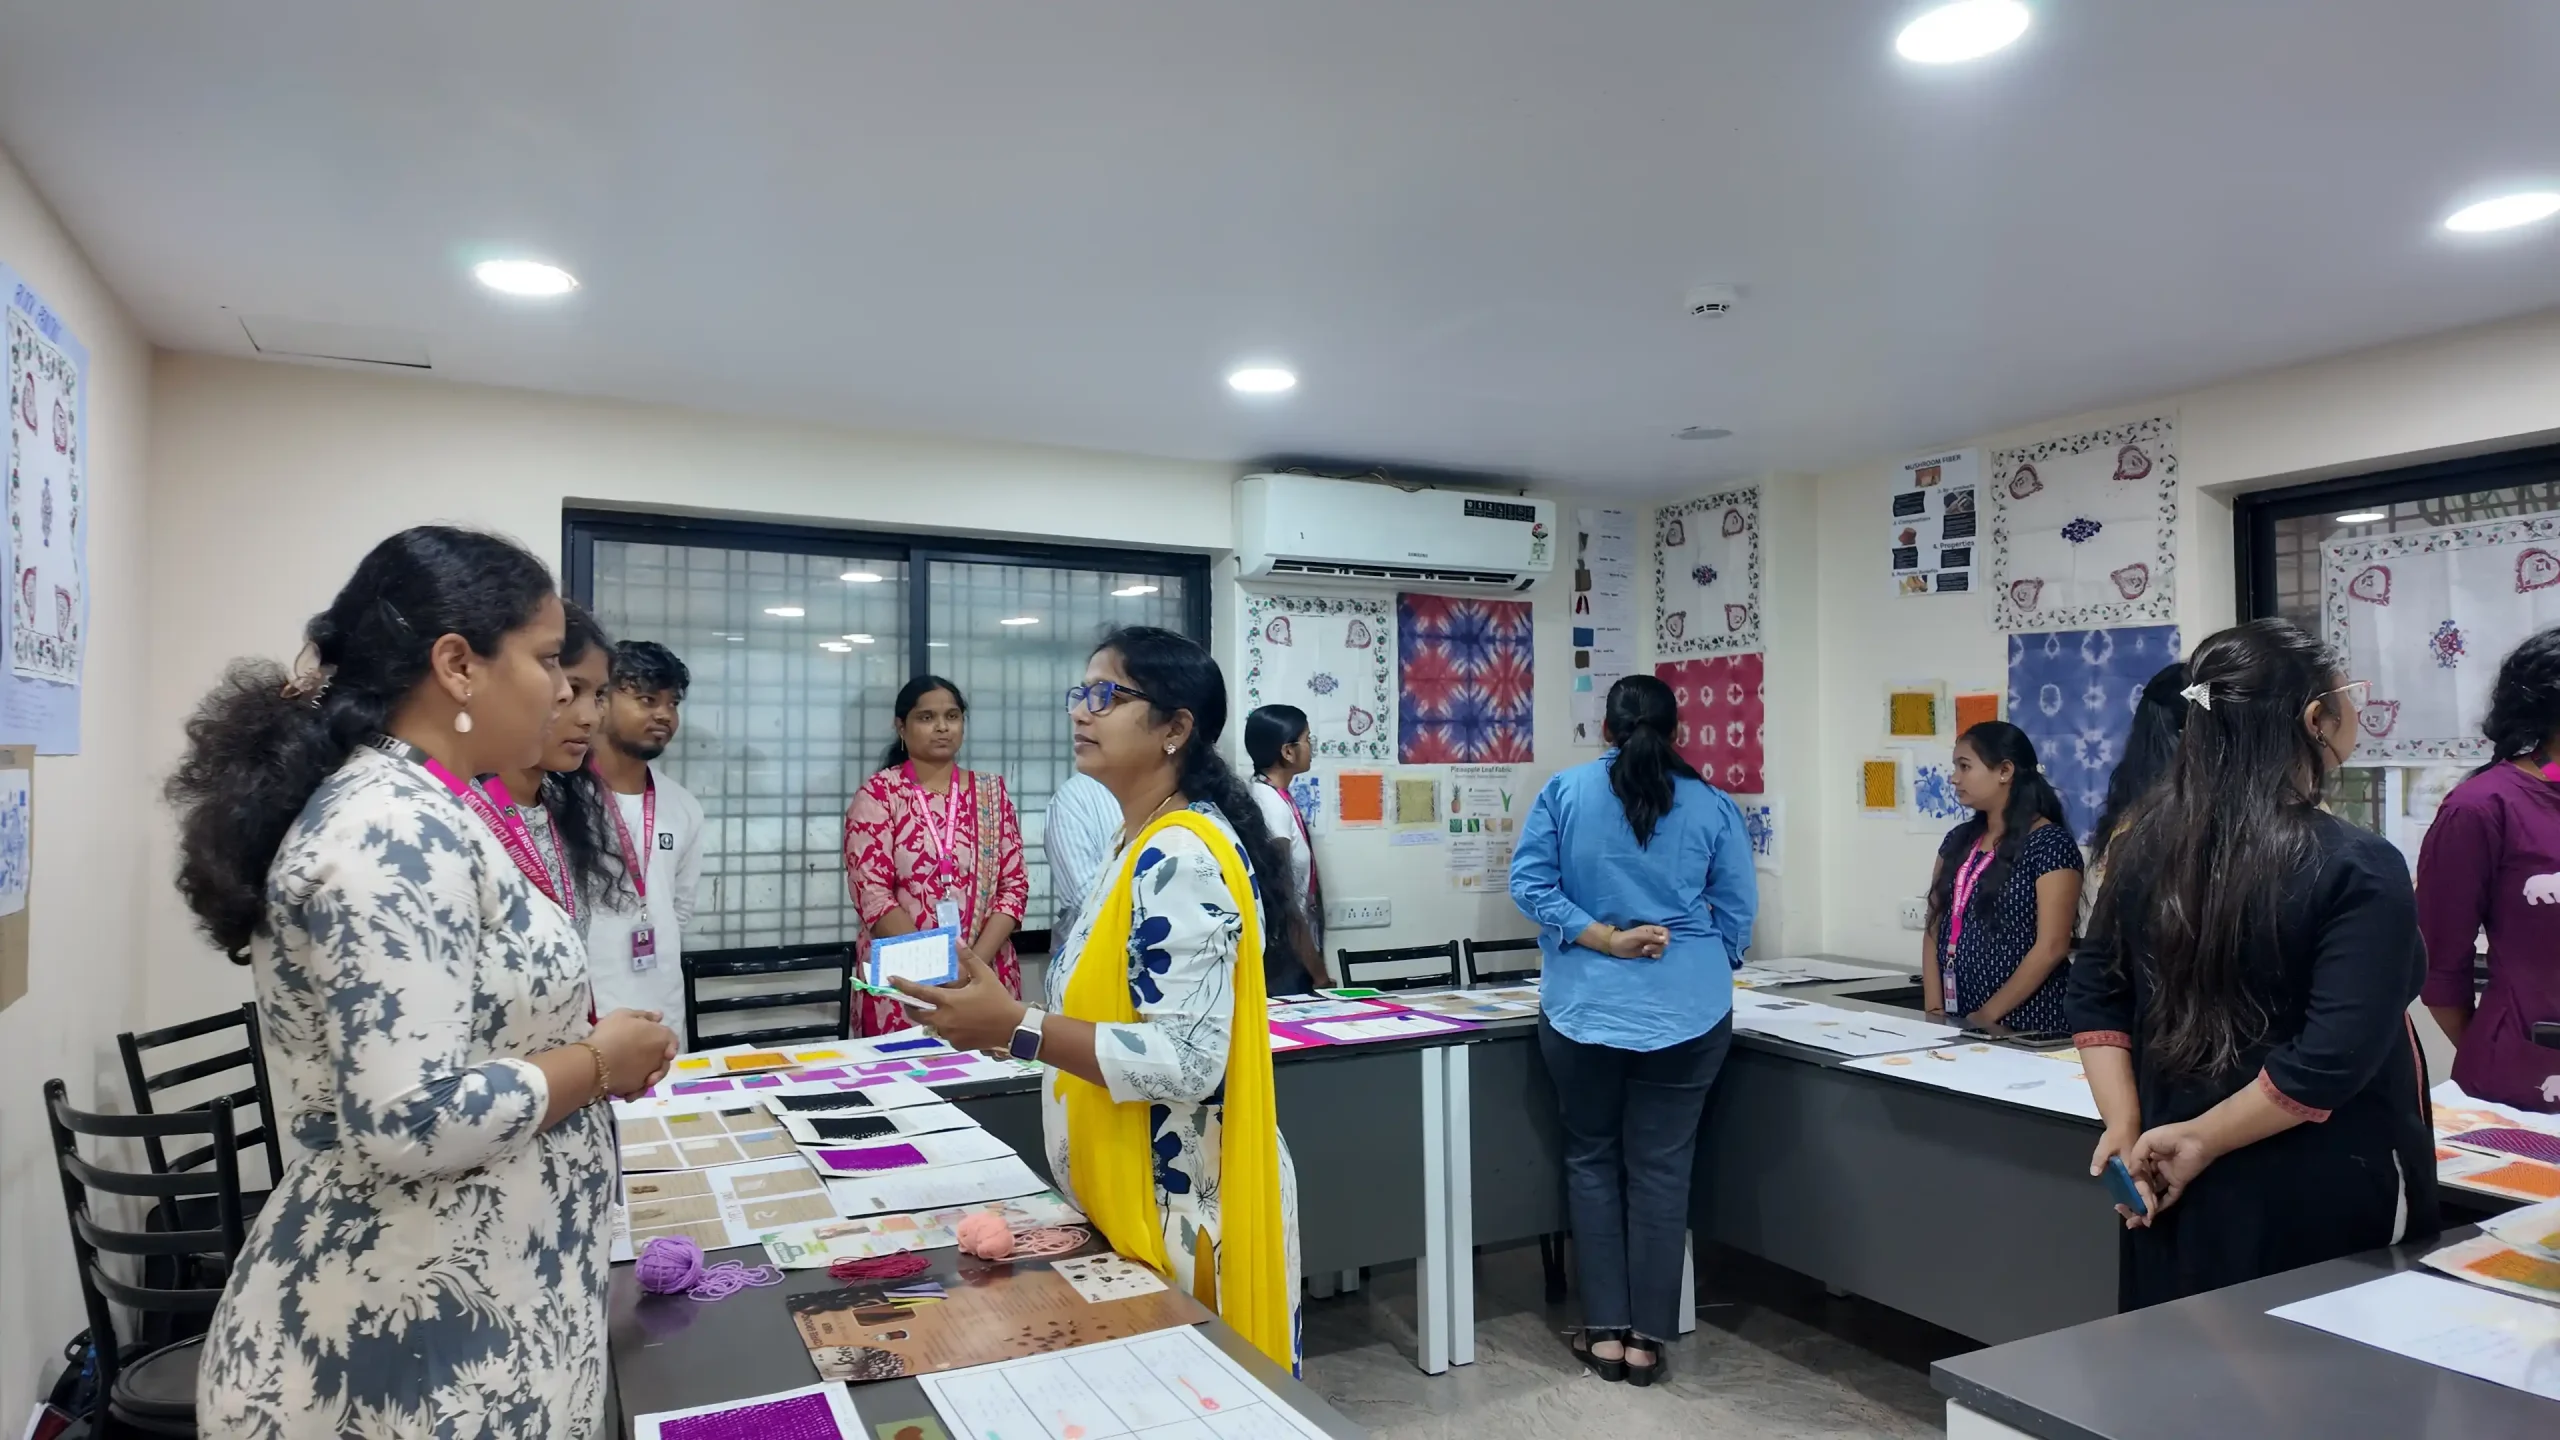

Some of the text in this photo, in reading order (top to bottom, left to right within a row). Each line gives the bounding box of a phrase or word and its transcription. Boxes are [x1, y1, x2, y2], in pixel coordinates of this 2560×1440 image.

[1905, 454, 1961, 471] MUSHROOM FIBER
[1940, 540, 1975, 549] Properties
[1450, 765, 1512, 774] Pineapple Leaf Fabric
[459, 790, 514, 848] TECHNOLOGY
[506, 843, 543, 883] FASHION
